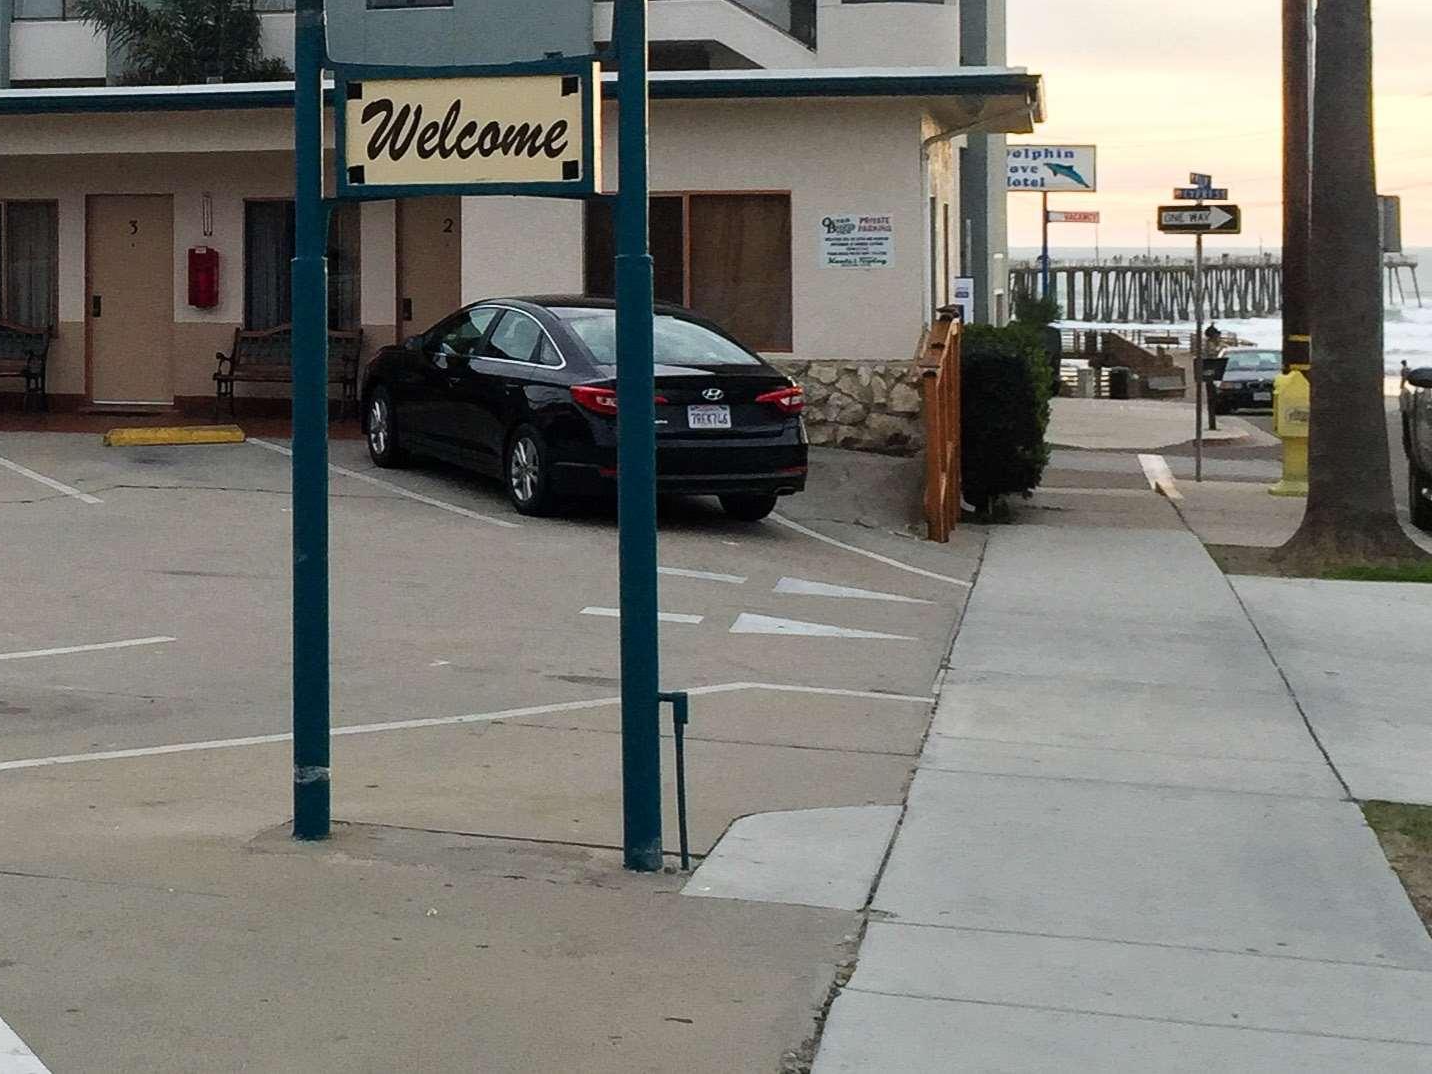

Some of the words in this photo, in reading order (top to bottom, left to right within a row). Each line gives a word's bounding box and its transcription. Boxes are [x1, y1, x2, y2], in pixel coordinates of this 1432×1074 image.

[361, 98, 569, 161] Welcome
[1008, 165, 1039, 174] ave
[443, 217, 454, 233] 2
[1164, 212, 1185, 223] ONE
[1189, 212, 1211, 223] WAY
[128, 219, 138, 235] 3
